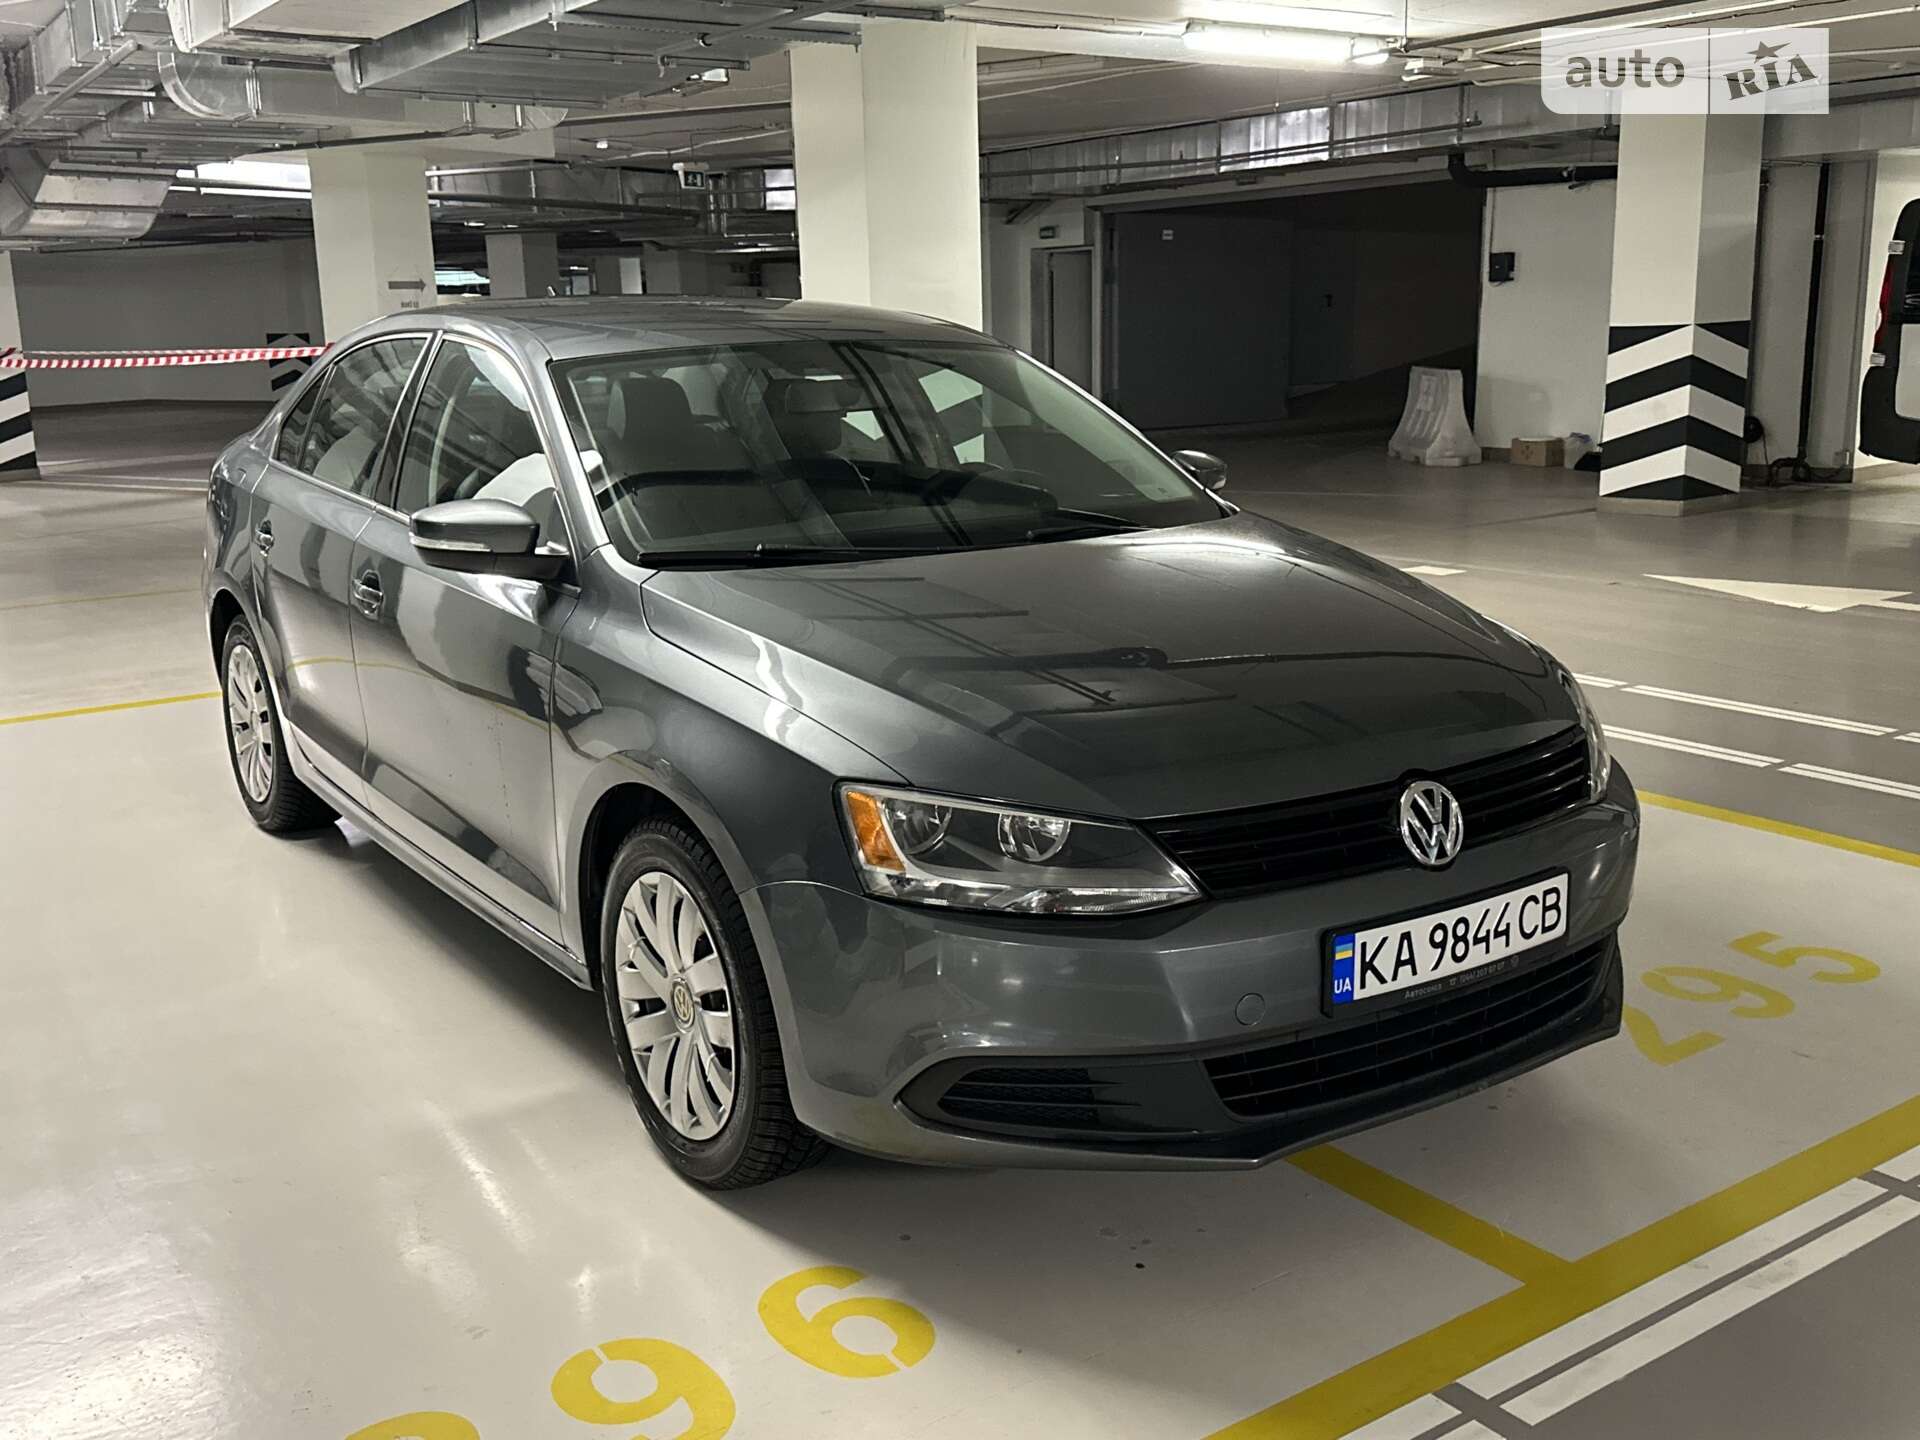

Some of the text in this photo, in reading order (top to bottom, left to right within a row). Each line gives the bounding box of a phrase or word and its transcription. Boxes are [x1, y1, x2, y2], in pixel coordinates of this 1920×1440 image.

[1333, 976, 1352, 995] UA
[1359, 930, 1418, 990] KA
[1428, 902, 1512, 972] 9844
[1518, 886, 1562, 940] CB
[345, 1265, 935, 1440] 96
